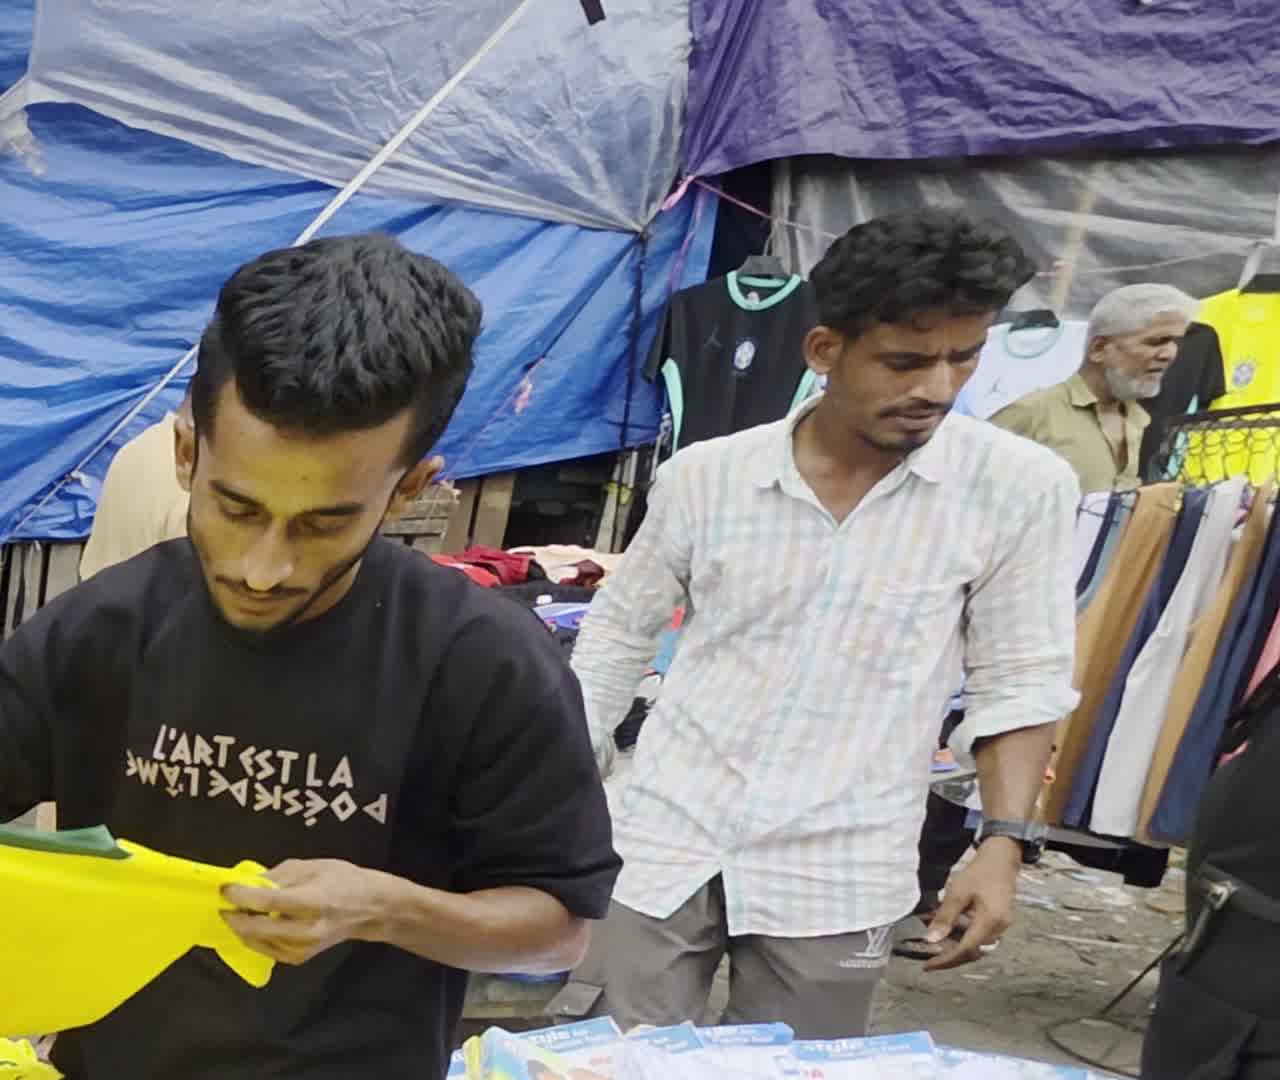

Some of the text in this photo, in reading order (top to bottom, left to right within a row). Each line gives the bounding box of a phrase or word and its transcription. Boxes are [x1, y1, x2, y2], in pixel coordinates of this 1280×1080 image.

[153, 724, 354, 788] L'ART EST LA
[207, 769, 249, 807] DE
